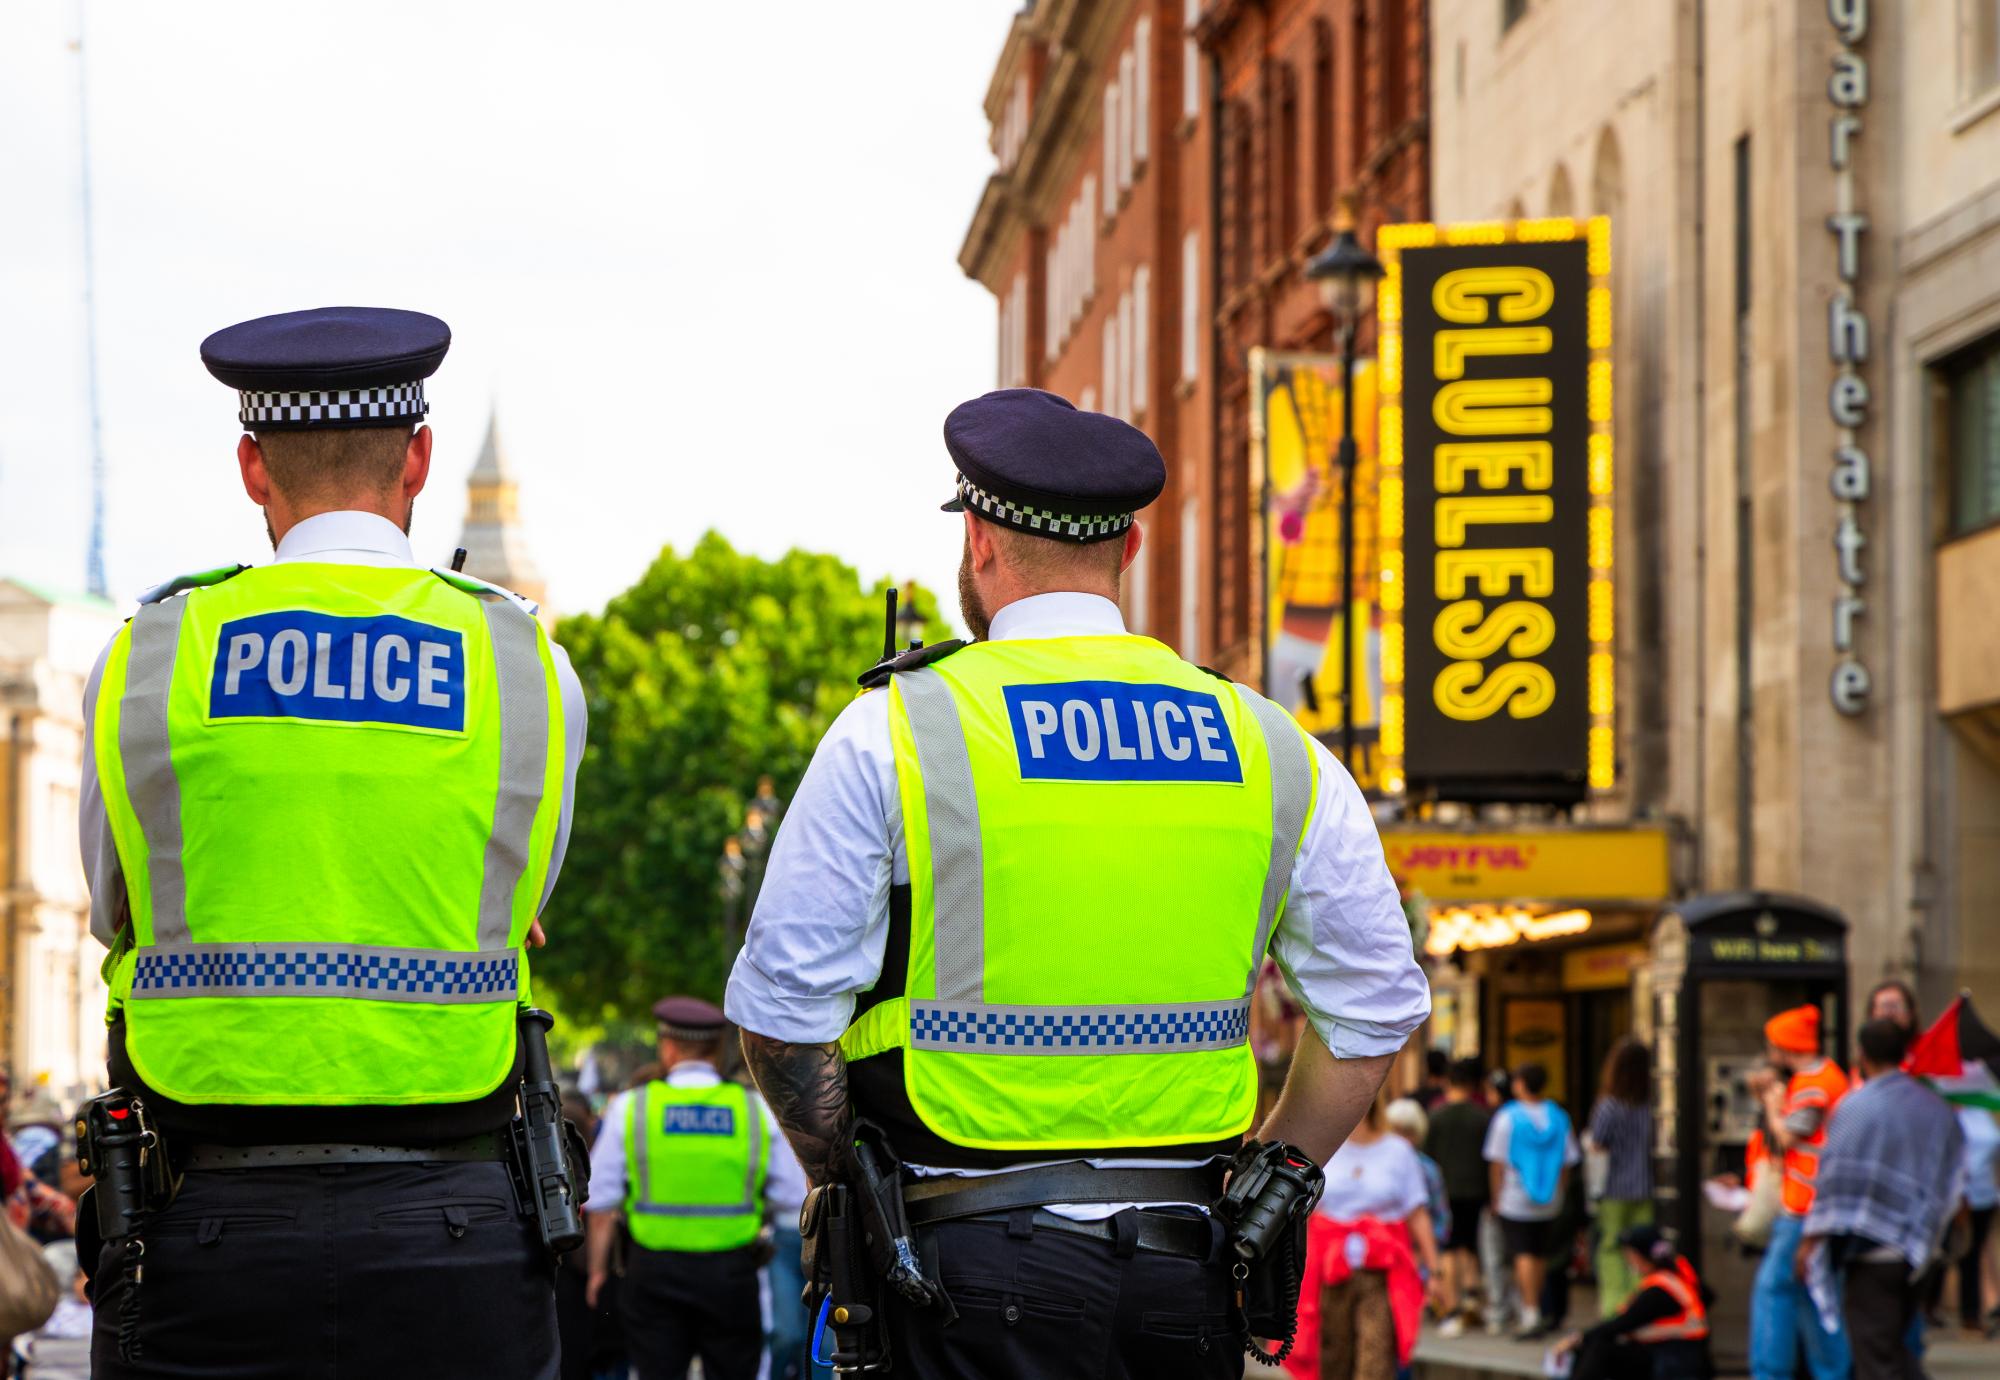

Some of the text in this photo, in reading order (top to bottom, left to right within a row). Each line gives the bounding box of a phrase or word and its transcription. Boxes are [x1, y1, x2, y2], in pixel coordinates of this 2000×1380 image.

[1432, 266, 1556, 721] CLUELESS
[1827, 212, 1870, 716] Theatre
[224, 628, 451, 709] POLICE
[1020, 698, 1229, 763] POLICE
